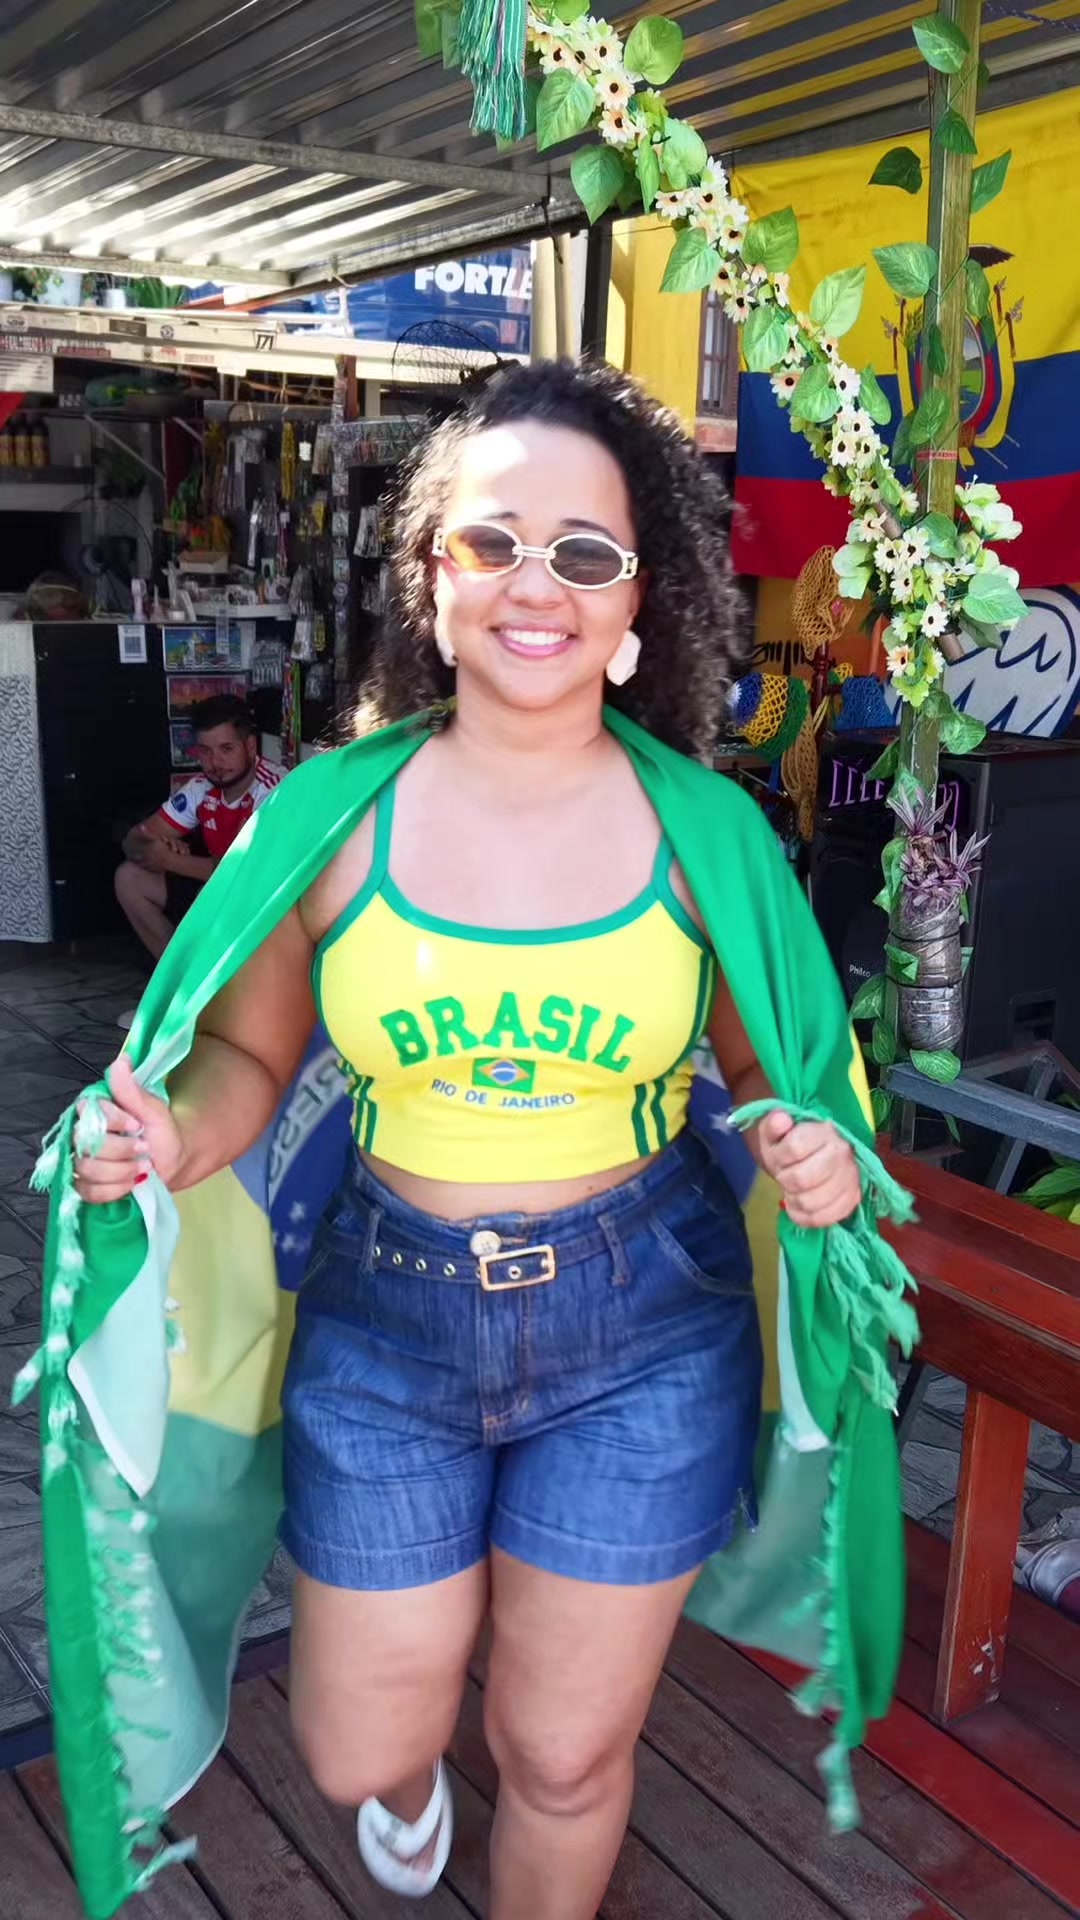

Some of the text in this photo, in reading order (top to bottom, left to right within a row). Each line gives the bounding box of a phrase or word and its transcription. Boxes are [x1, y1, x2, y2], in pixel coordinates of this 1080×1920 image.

[849, 964, 871, 978] Philco
[379, 991, 636, 1073] BRASIL
[431, 1078, 576, 1110] RIO DE JANEIRO
